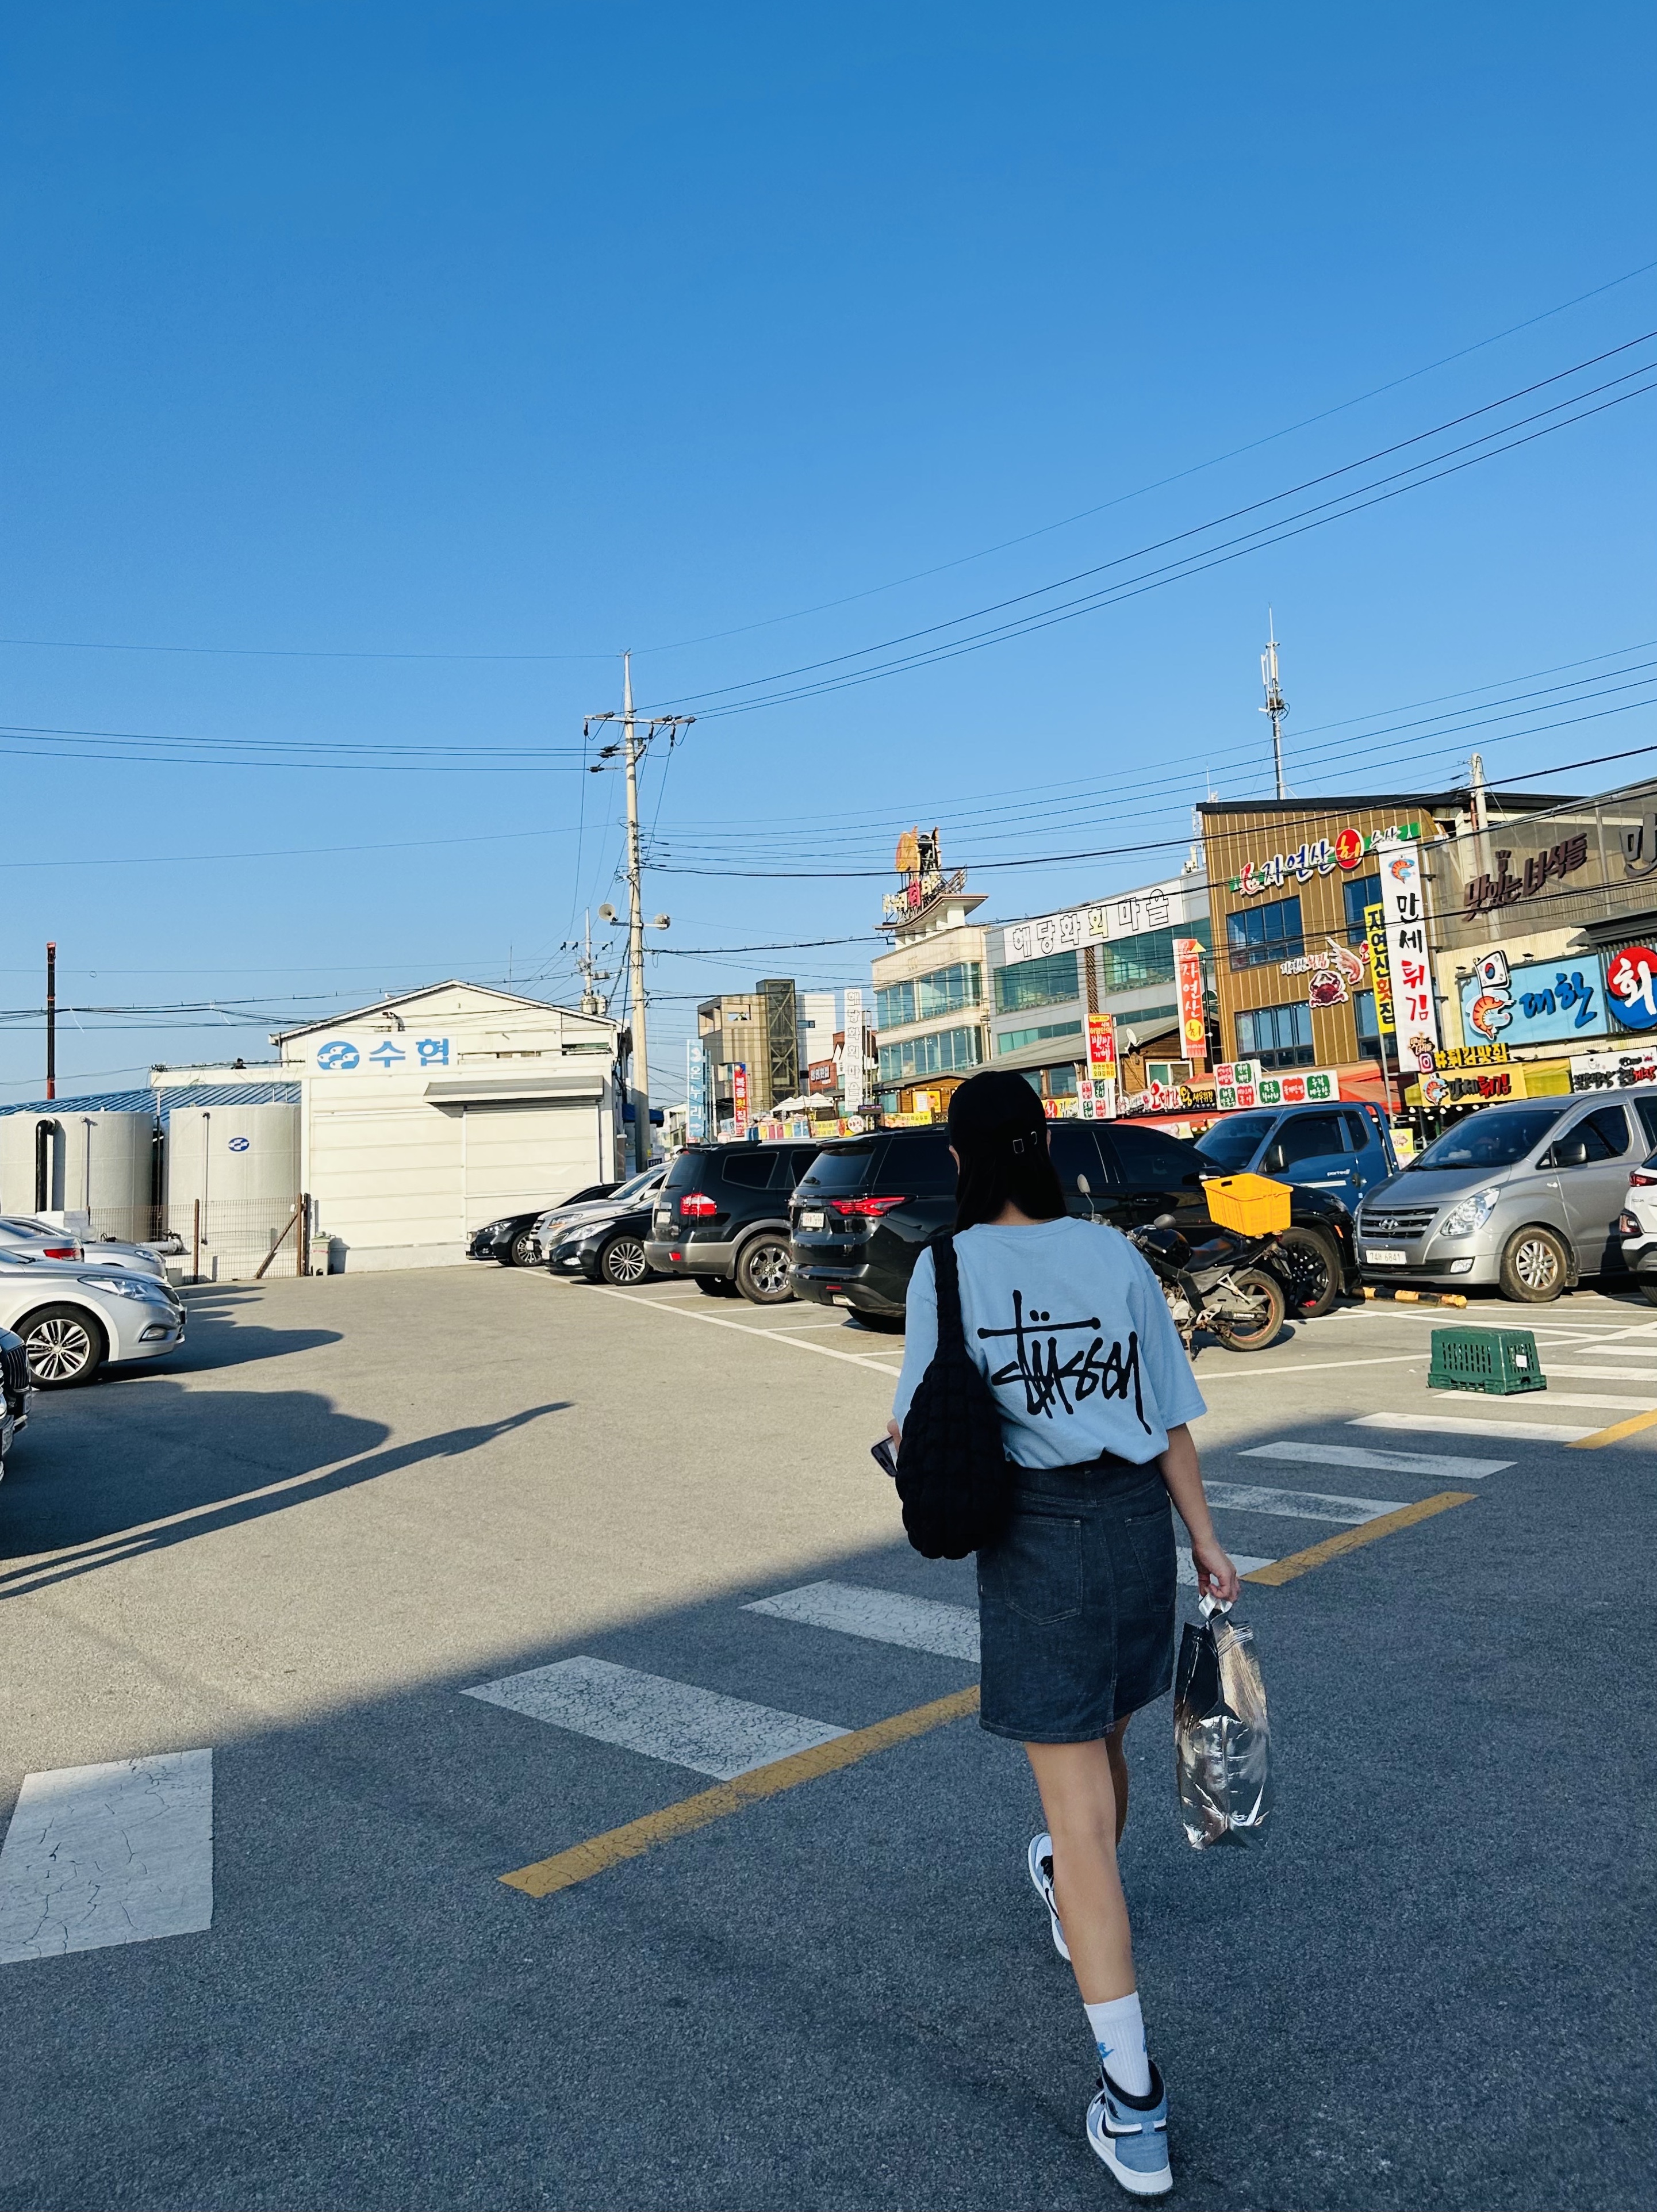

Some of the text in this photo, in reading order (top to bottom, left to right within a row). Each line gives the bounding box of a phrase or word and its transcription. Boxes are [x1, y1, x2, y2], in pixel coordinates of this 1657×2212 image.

[1613, 957, 1657, 1015] 회
[369, 1038, 448, 1068] 수협
[1385, 1253, 1401, 1262] 6841
